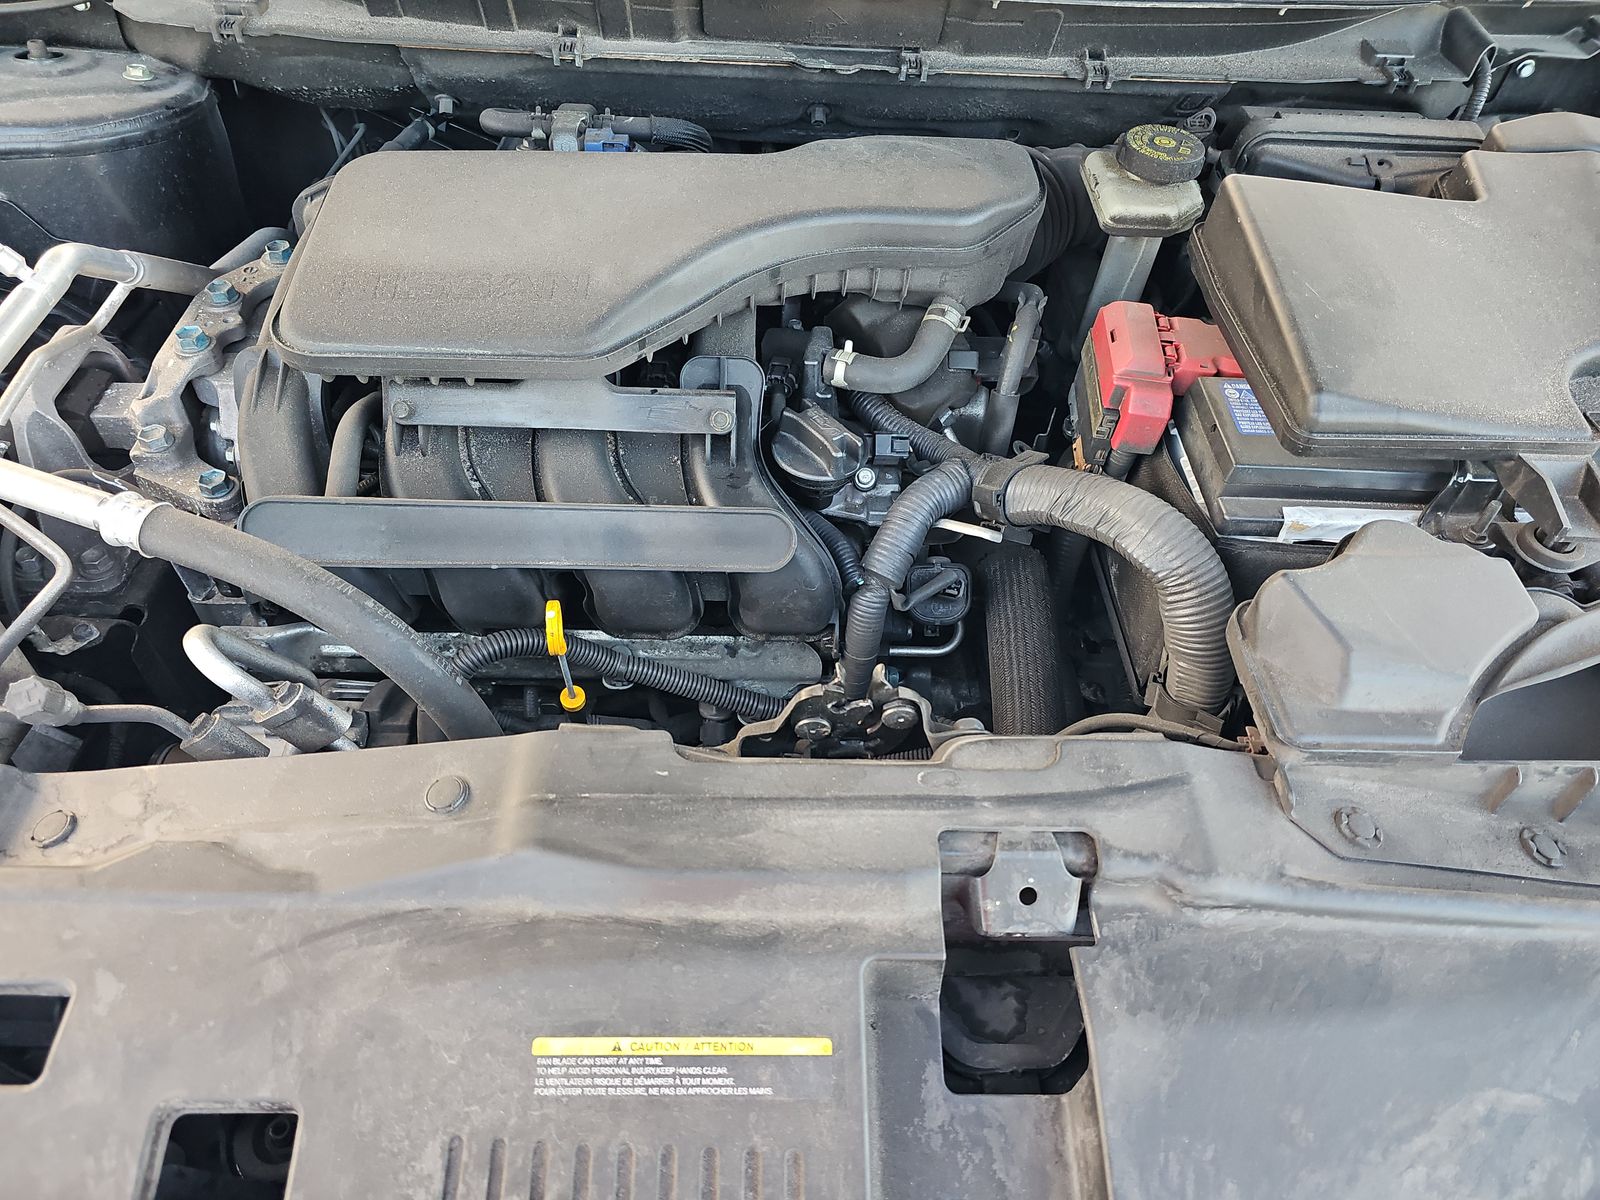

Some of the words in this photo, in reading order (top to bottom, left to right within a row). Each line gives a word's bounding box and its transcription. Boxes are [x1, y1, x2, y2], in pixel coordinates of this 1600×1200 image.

[630, 1041, 681, 1052] CAUTION
[693, 1041, 754, 1052] ATTENTION
[536, 1057, 552, 1066] FAN
[552, 1057, 577, 1066] BLADE
[577, 1057, 595, 1066] CAN
[595, 1057, 618, 1066] START
[618, 1057, 628, 1066] AT
[628, 1057, 644, 1066] ANY
[536, 1066, 547, 1075] TO
[547, 1066, 567, 1075] HELP
[568, 1066, 591, 1075] AVOID
[591, 1066, 631, 1075] PERSONAL
[675, 1066, 702, 1075] HANDS
[534, 1077, 545, 1086] LE
[545, 1077, 593, 1086] VENTILATEUR
[593, 1077, 622, 1086] RISQUE
[622, 1077, 633, 1086] DE
[633, 1075, 674, 1086] DÉMARRER
[682, 1077, 701, 1086] TOUT
[533, 1087, 556, 1096] POUR
[583, 1087, 607, 1096] TOUTE
[648, 1087, 660, 1096] NE
[660, 1087, 676, 1096] PAS
[676, 1087, 687, 1096] EN
[687, 1087, 734, 1096] APPROCHER
[734, 1087, 748, 1096] LES
